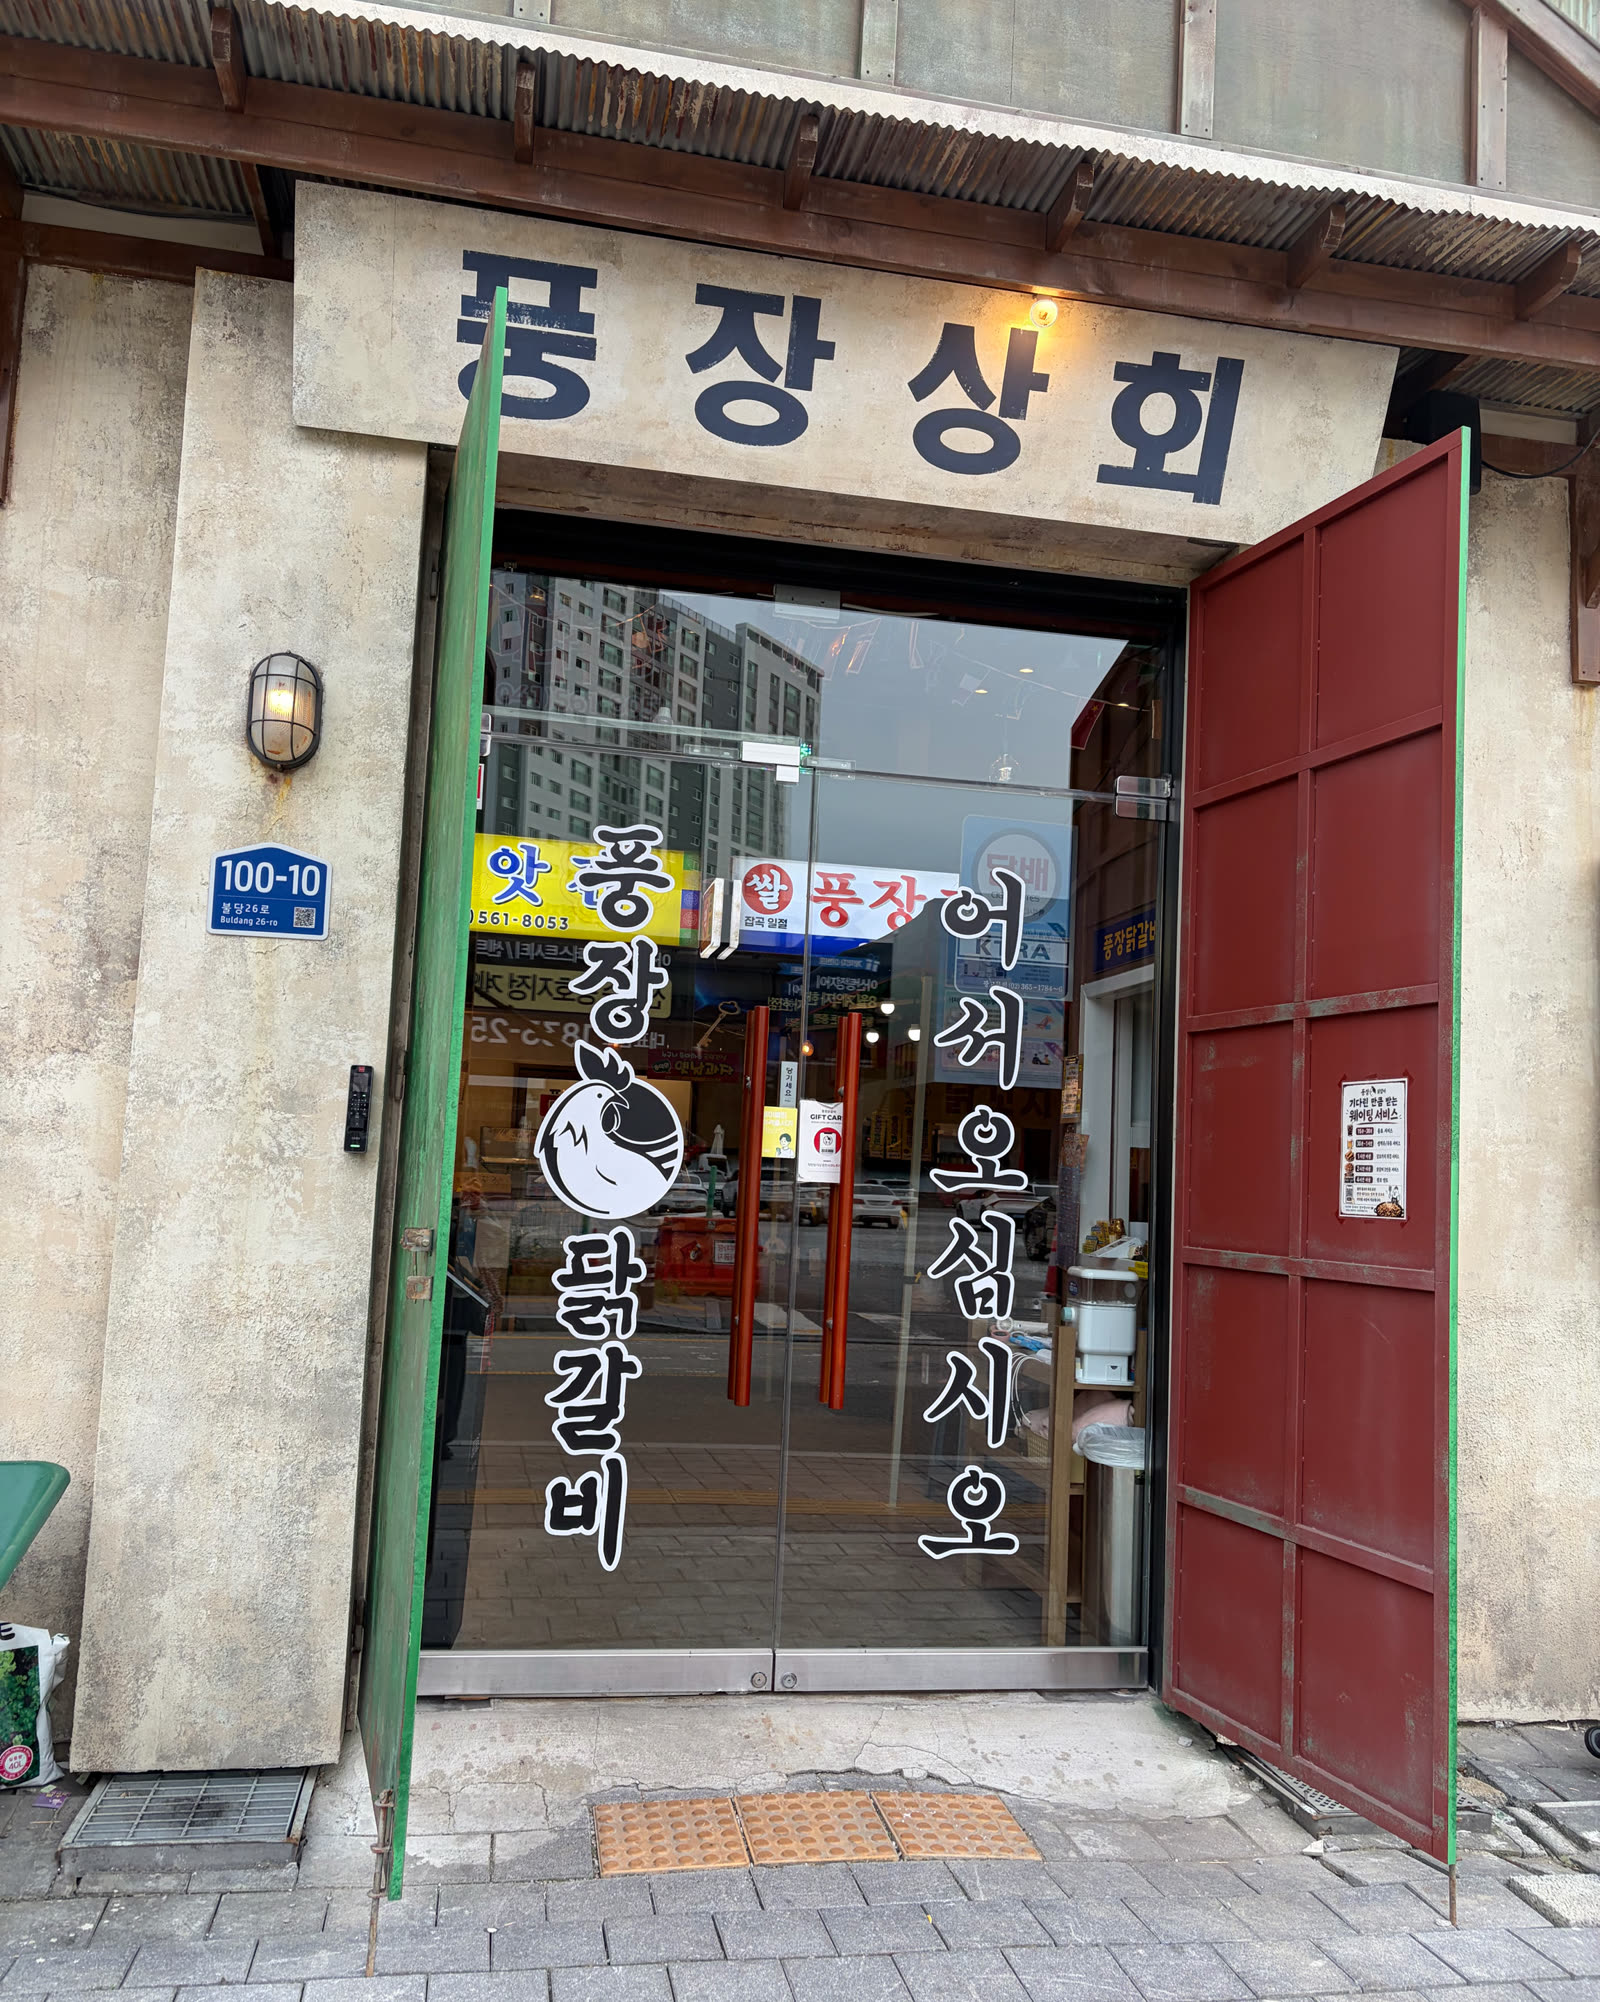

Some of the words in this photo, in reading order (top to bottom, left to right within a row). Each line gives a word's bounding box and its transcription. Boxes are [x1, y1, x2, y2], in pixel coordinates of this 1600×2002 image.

[456, 249, 1245, 505] 풍장상회
[221, 860, 320, 896] 100-10
[745, 868, 789, 911] 쌀
[221, 902, 270, 915] 불당26로
[810, 871, 957, 931] 풍장
[220, 915, 253, 927] Buldang
[255, 917, 278, 927] 26-ro
[569, 825, 674, 1043] 풍장
[744, 916, 765, 928] 잡곡
[768, 917, 788, 930] 일절
[785, 1067, 793, 1097] 당기세요
[1349, 1097, 1369, 1108] 기다린
[1349, 1108, 1373, 1122] 웨이팅
[1375, 1107, 1399, 1121] 서비스
[918, 867, 1029, 1559] 어서오십시오
[545, 1226, 647, 1572] 닭갈비
